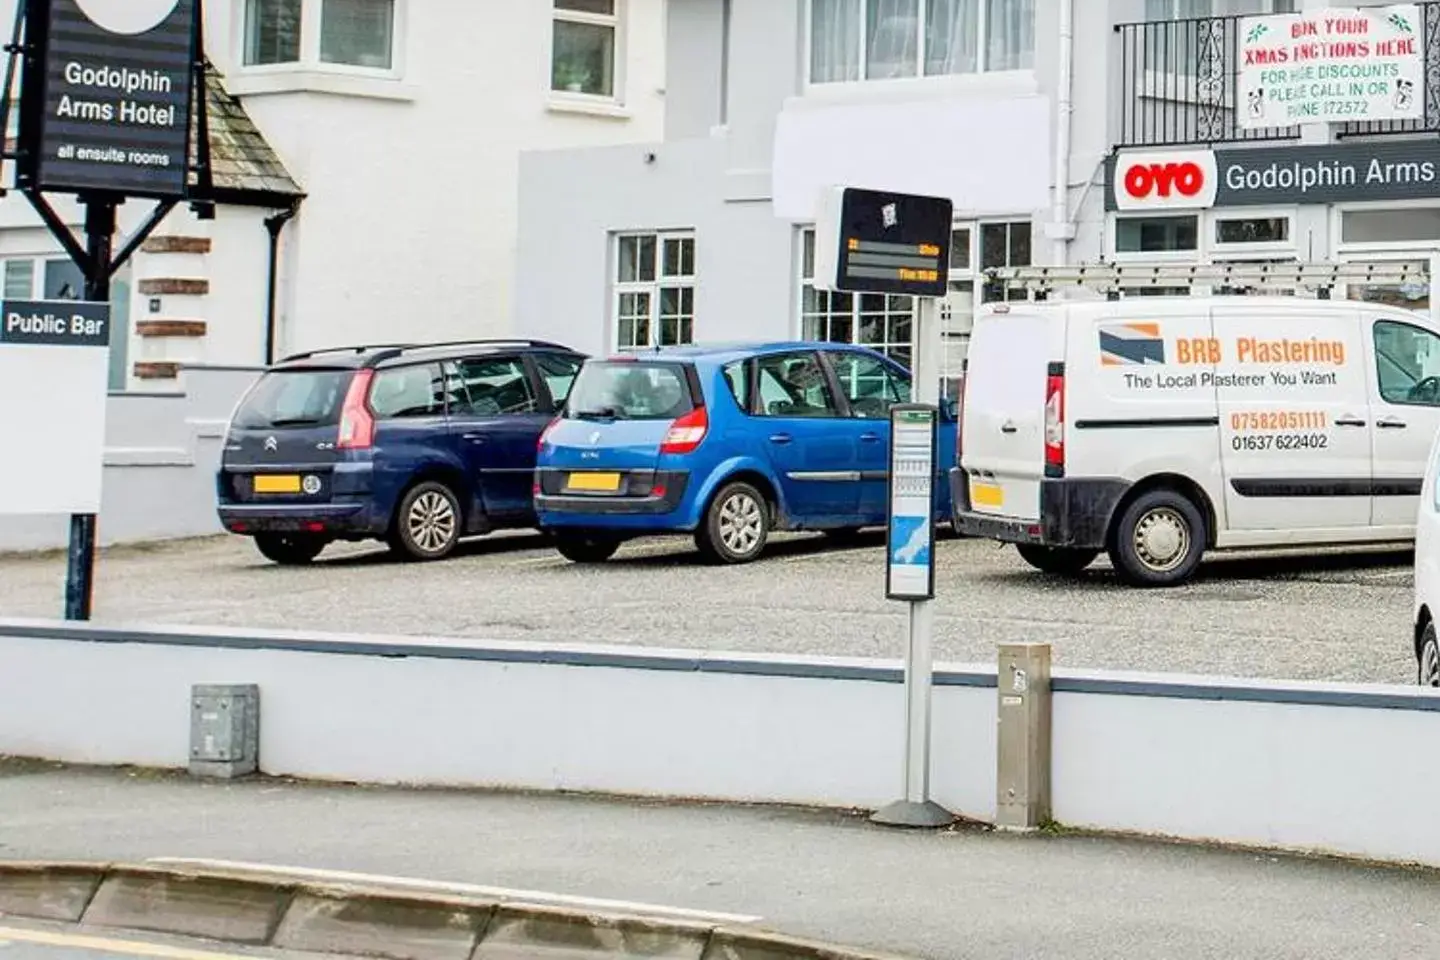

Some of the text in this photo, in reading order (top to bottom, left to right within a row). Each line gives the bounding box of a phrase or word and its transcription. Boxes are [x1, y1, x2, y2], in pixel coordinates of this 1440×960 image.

[1324, 18, 1369, 35] YOUR
[1245, 47, 1288, 65] XMAS
[1375, 38, 1417, 57] HERE
[64, 61, 172, 93] Godolphin
[1260, 69, 1288, 84] FOR
[1318, 62, 1399, 80] DISCOUNTS
[1310, 82, 1345, 98] CALL
[1349, 82, 1364, 97] IN
[1367, 81, 1388, 96] OR
[57, 94, 175, 127] Arms Hotel
[57, 144, 170, 167] all ensuite rooms
[1125, 162, 1204, 198] OYO
[1226, 160, 1356, 192] Godolphin
[1365, 158, 1435, 183] Arms
[7, 312, 104, 335] Public Bar
[1176, 336, 1345, 365] BRB Plastering
[1123, 370, 1337, 389] The Local Plasterer You Want
[1231, 411, 1326, 430] 07582051111
[1232, 433, 1328, 451] 01637 622402
